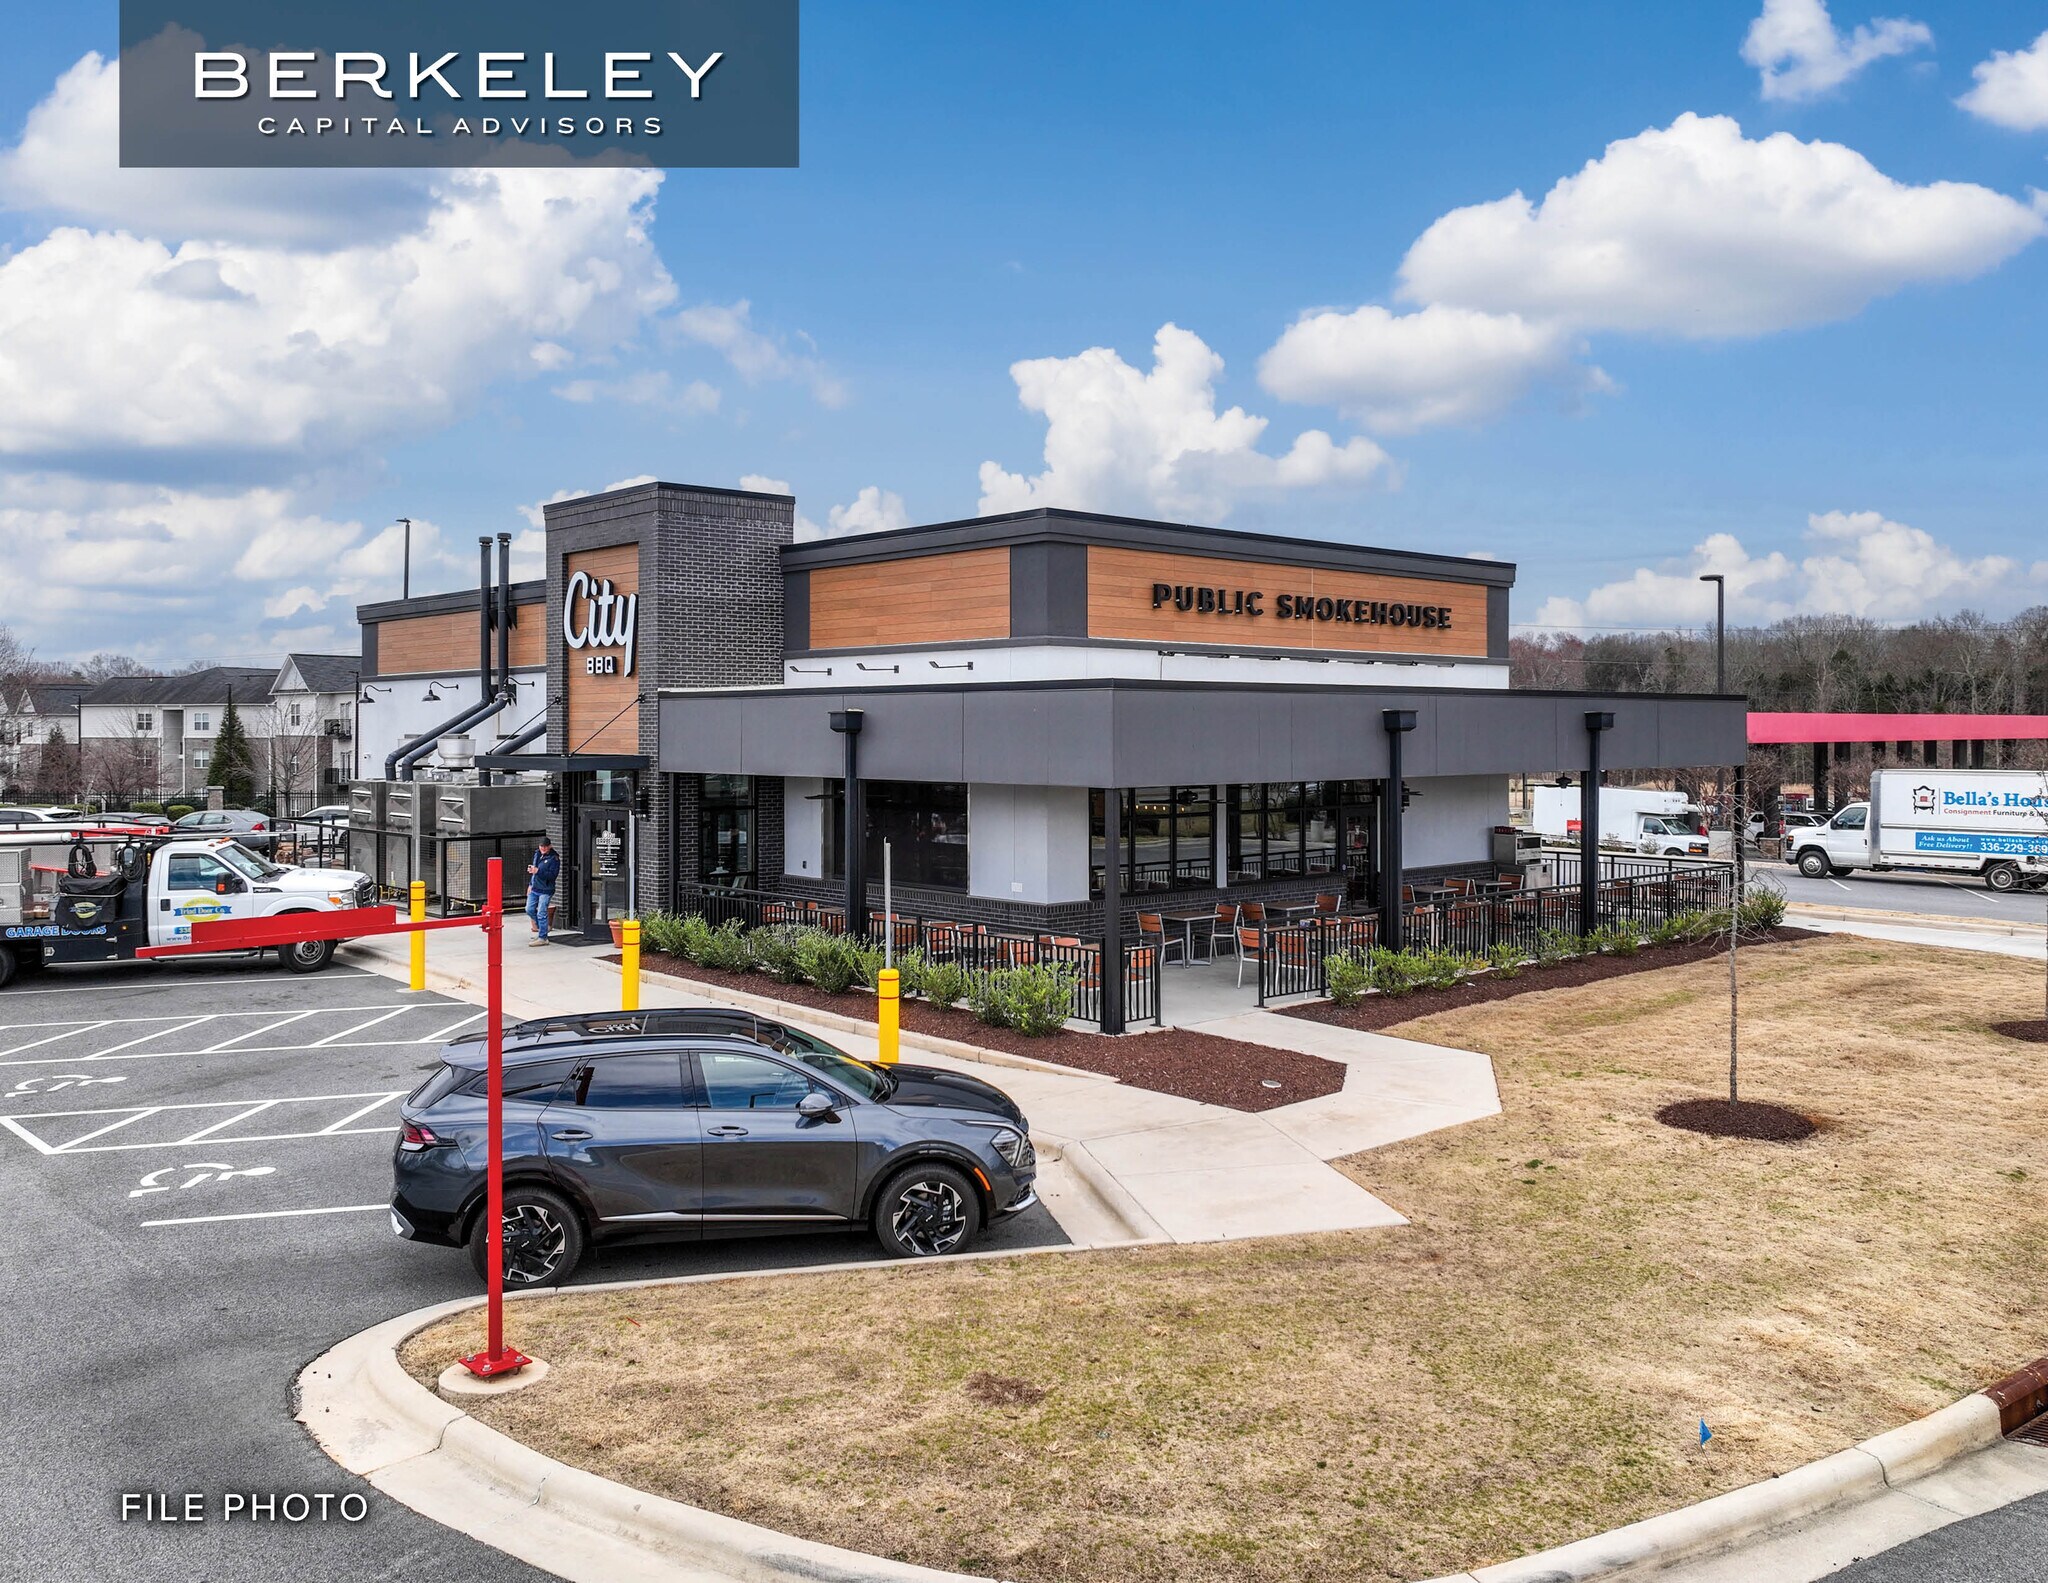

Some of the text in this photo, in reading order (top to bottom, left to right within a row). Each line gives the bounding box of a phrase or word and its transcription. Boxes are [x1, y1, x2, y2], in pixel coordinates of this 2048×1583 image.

[1152, 583, 1453, 629] PUBLIC SMOKEHOUSE
[563, 571, 638, 678] City
[586, 656, 615, 674] BBQ
[1943, 791, 1999, 806] Bella's
[1943, 808, 1991, 816] Consignment
[1992, 809, 2027, 817] Furniture
[6, 926, 59, 938] GARAGE
